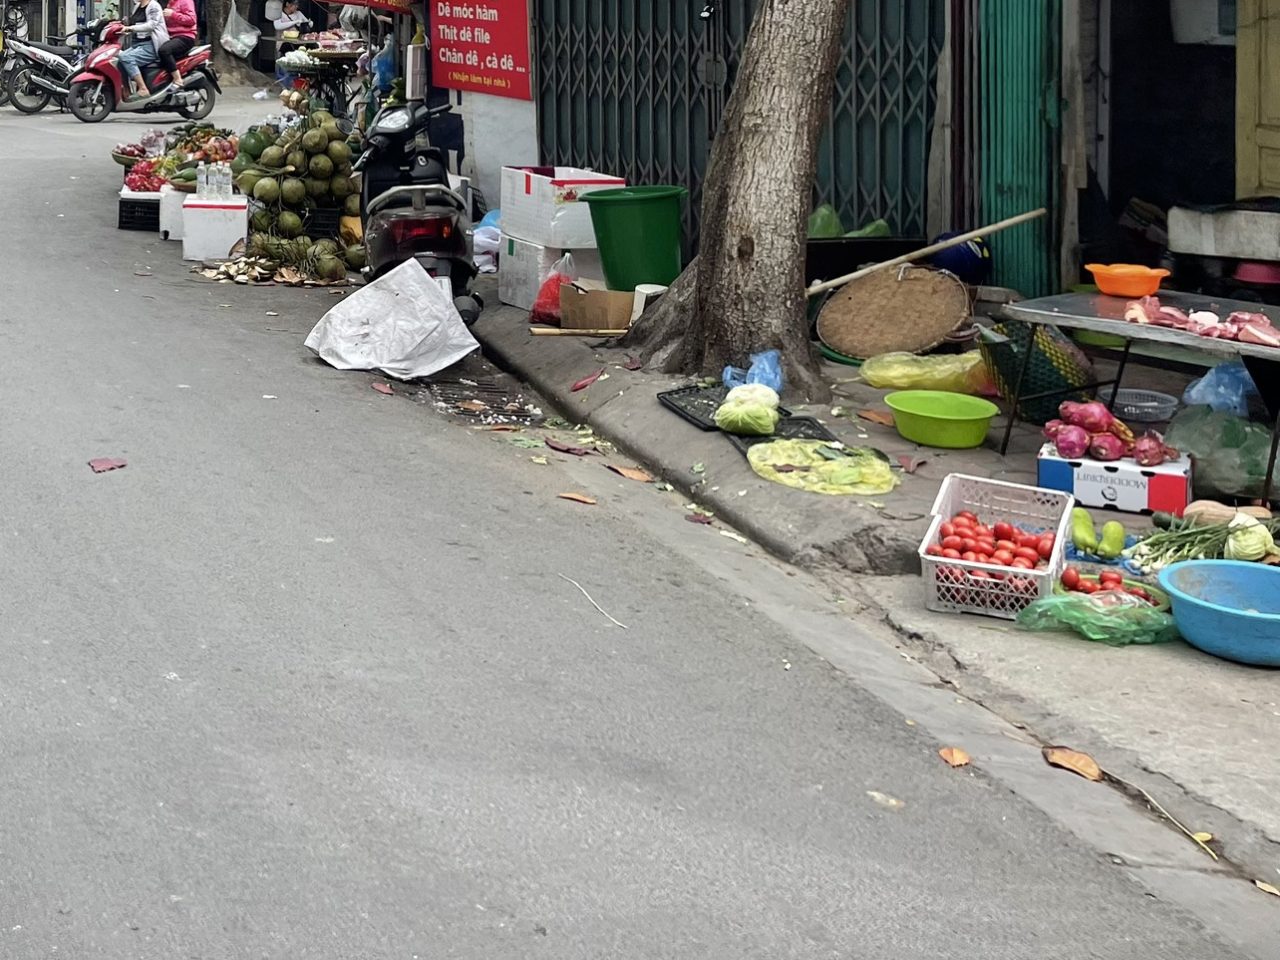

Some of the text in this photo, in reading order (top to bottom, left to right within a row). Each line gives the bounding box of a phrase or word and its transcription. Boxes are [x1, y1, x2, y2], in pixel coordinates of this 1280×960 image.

[437, 2, 450, 17] Dê
[476, 6, 498, 21] hàm
[438, 25, 491, 44] Thịt dê file
[439, 47, 463, 65] Chân
[466, 48, 478, 66] dê
[486, 52, 498, 69] cà
[500, 54, 514, 71] dê
